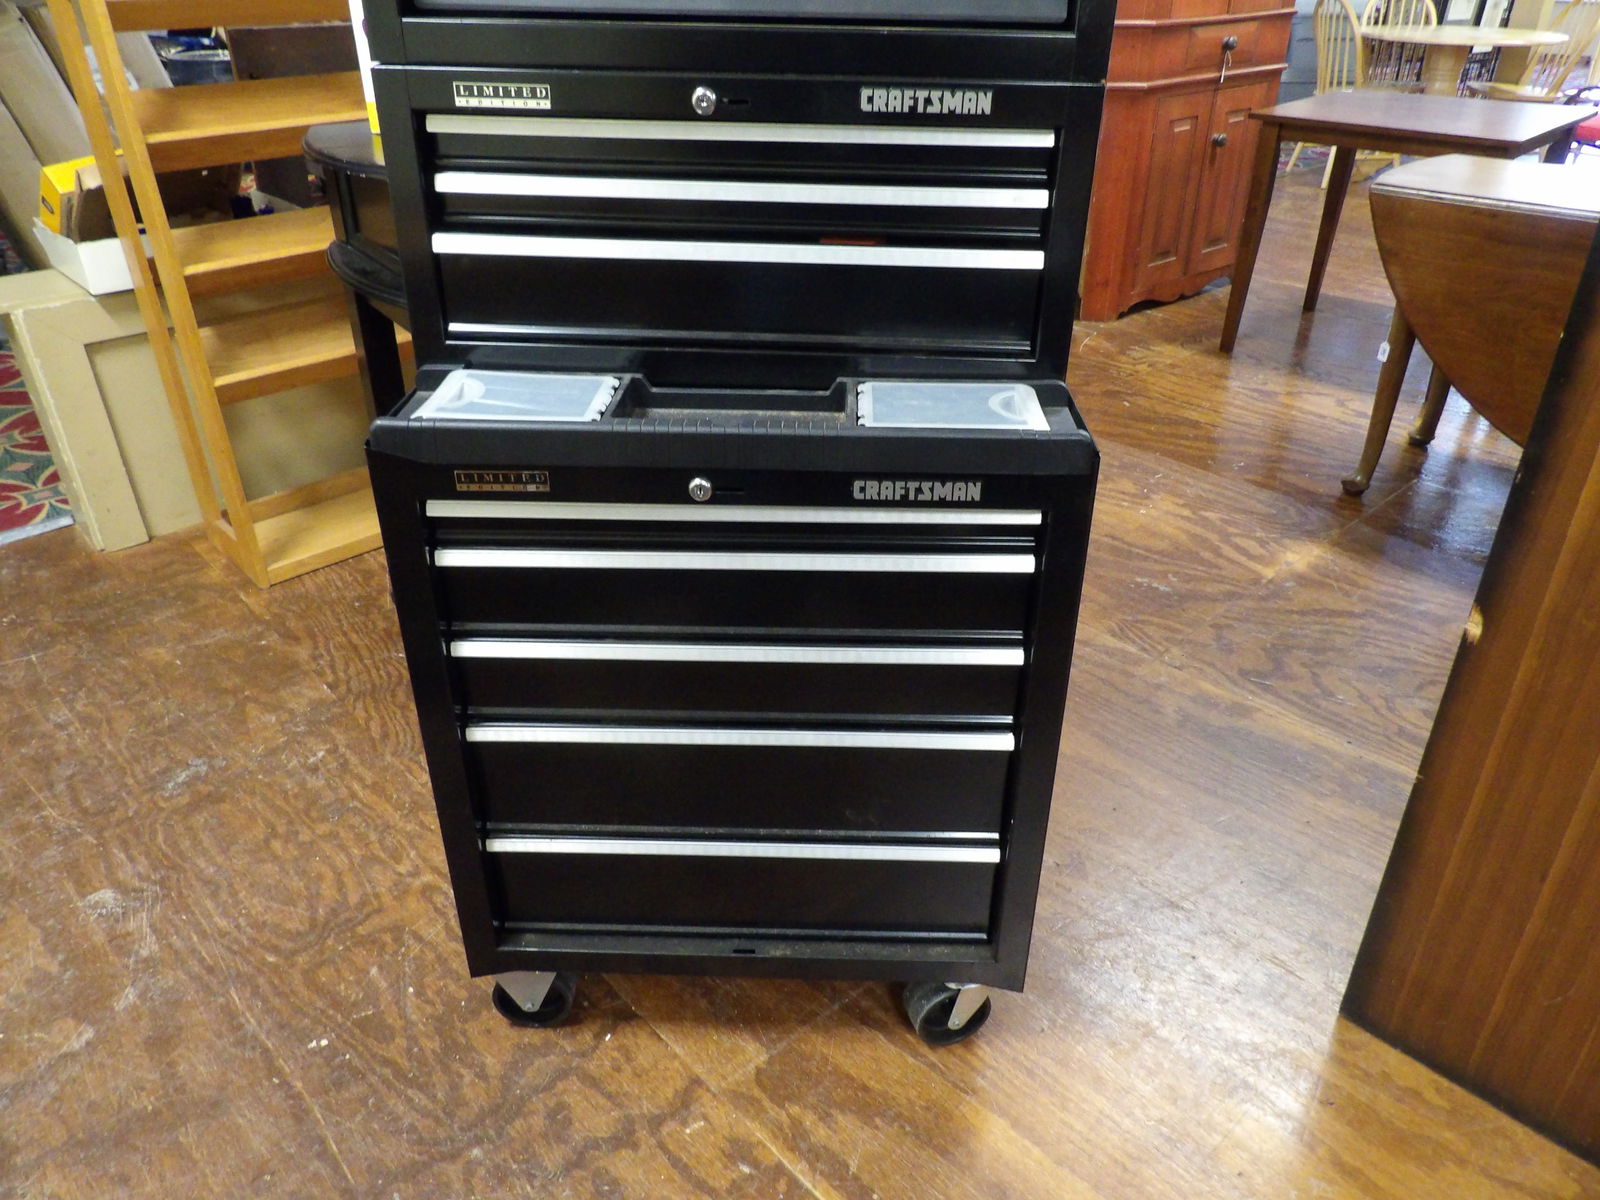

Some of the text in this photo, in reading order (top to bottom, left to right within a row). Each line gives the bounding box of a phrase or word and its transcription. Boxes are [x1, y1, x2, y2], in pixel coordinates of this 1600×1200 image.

[460, 85, 546, 98] LIMITED
[860, 87, 992, 115] CRAFTSMAN
[460, 473, 545, 483] LIMITED
[852, 480, 982, 502] CRAFTSMAN
